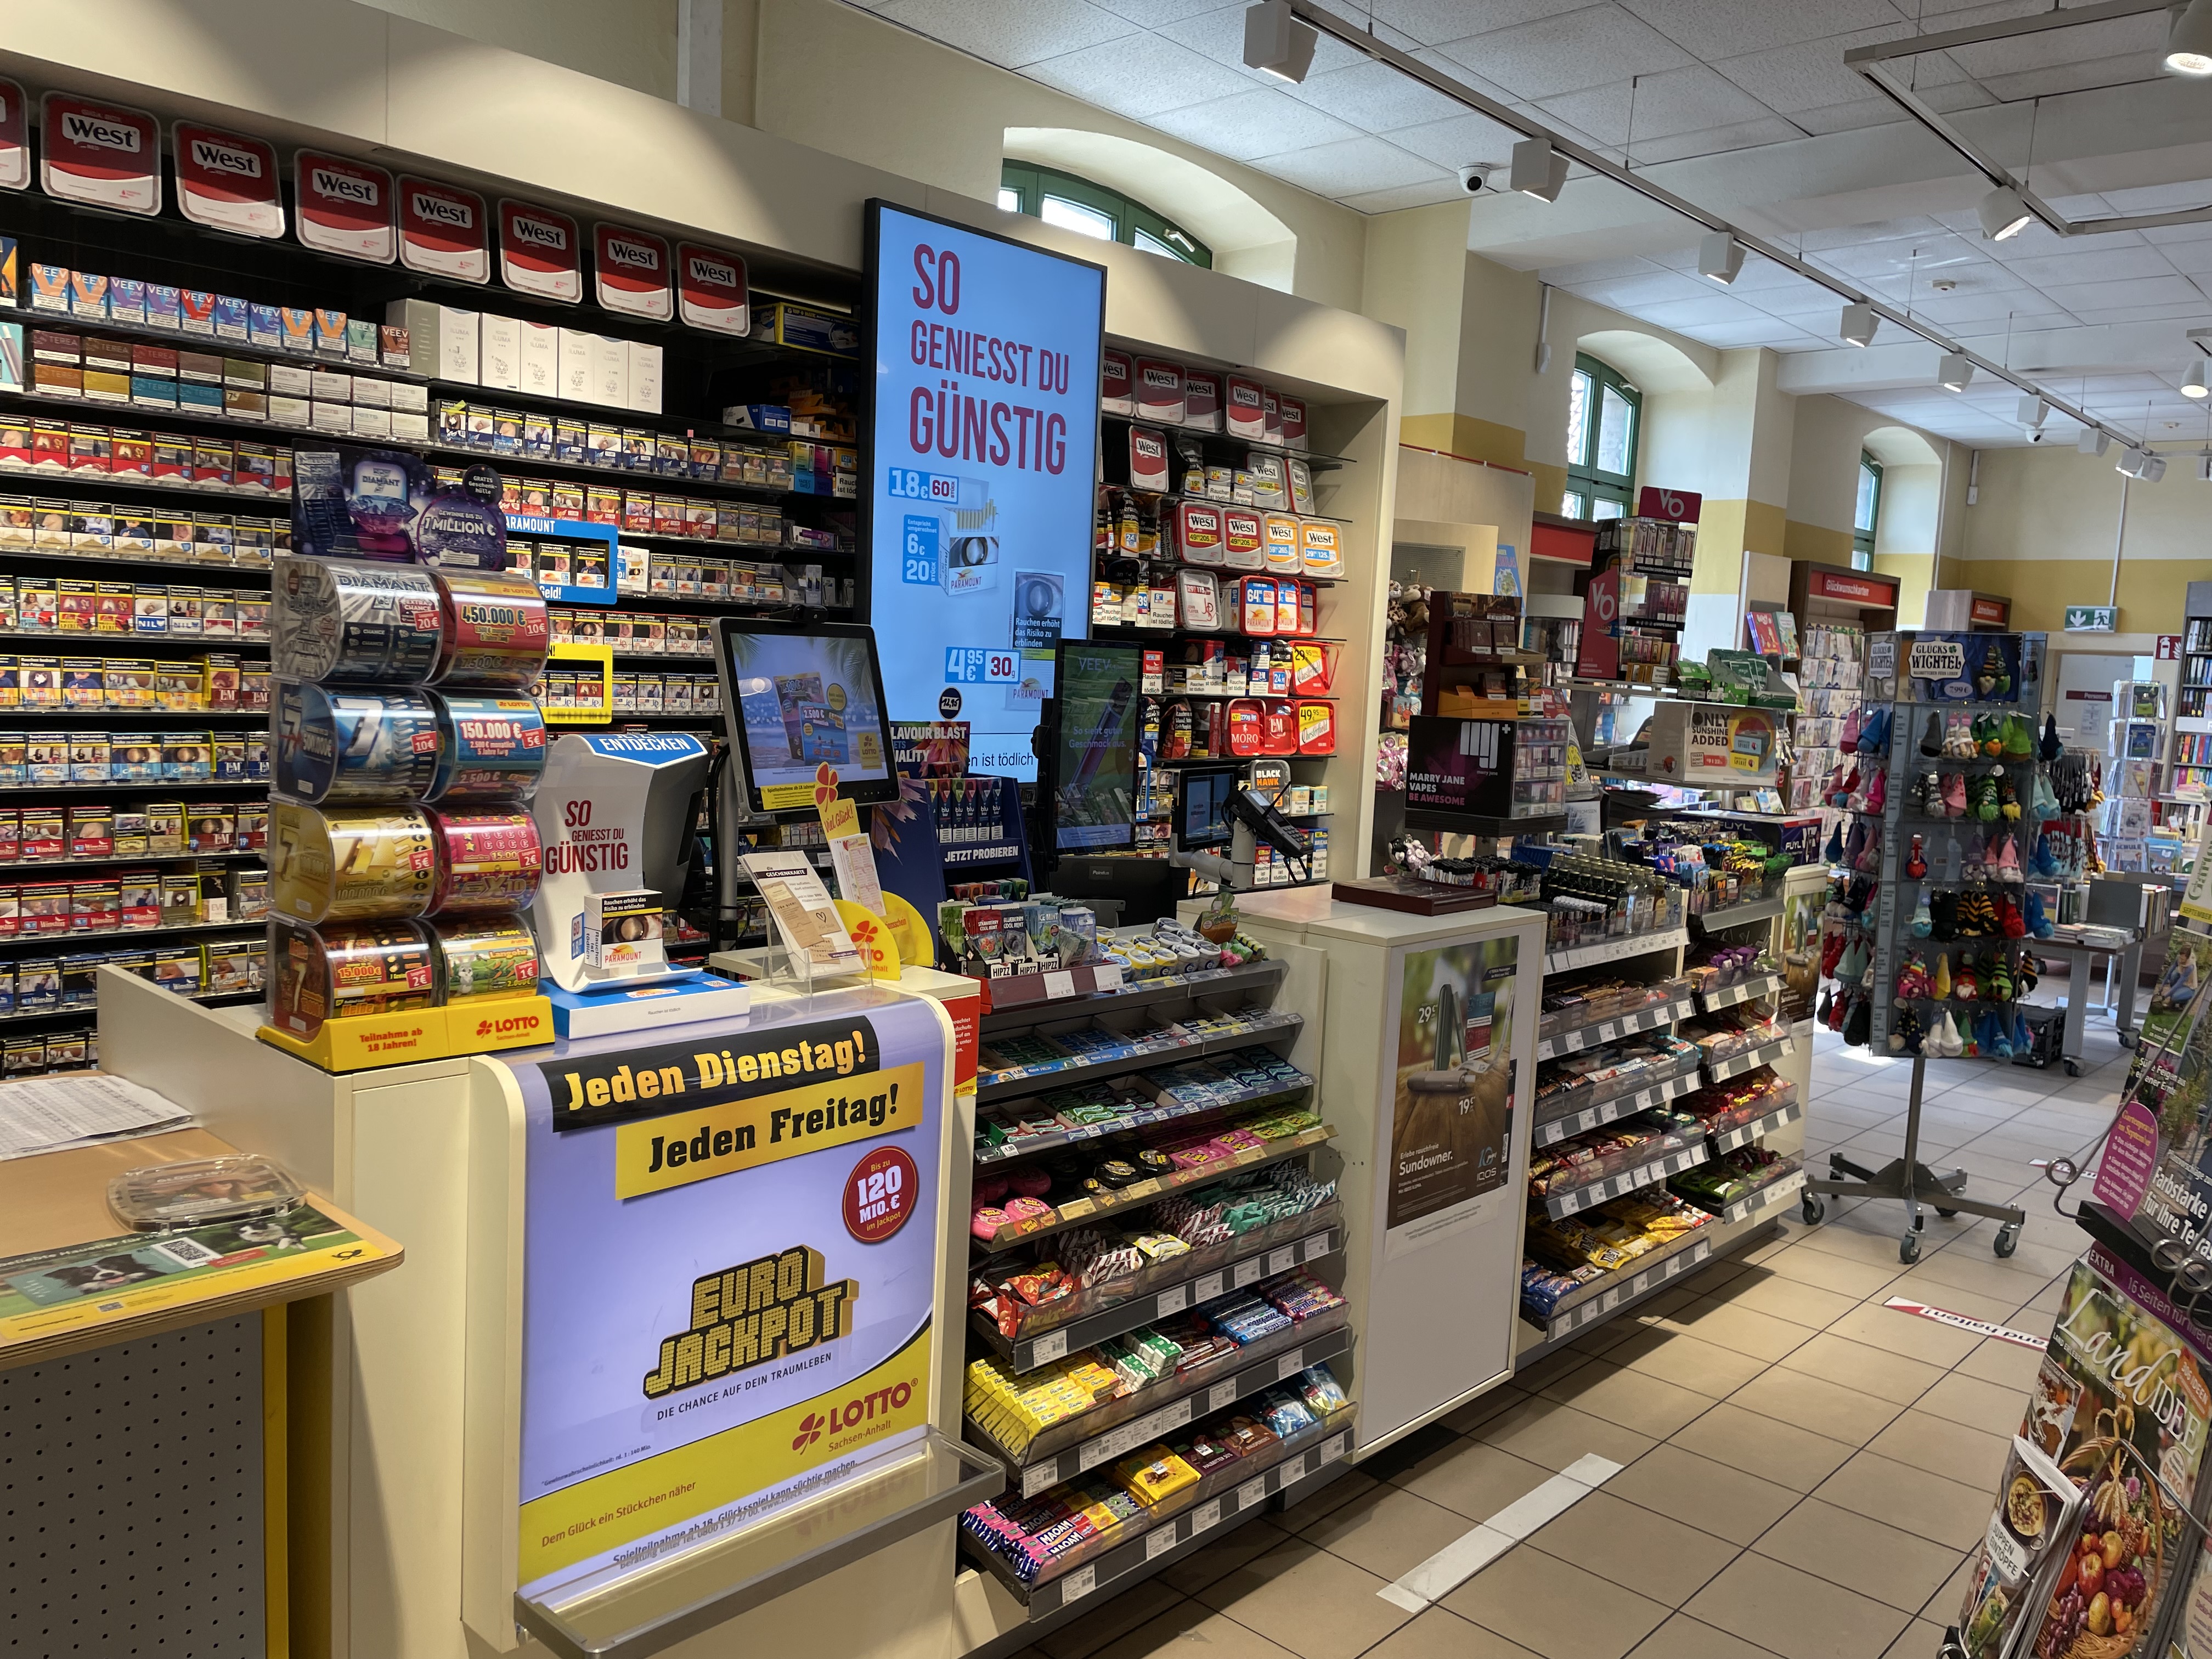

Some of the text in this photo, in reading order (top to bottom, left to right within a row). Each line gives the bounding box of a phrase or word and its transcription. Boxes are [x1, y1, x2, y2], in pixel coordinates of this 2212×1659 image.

[67, 116, 133, 148] West
[197, 145, 255, 173] West
[317, 172, 373, 202] West
[417, 196, 467, 225] West
[518, 219, 561, 246] West
[33, 264, 69, 279] VEEV
[913, 243, 960, 315] SO
[911, 320, 1069, 395] GENIESST DU
[910, 380, 1066, 475] GÜNSTIG
[362, 476, 400, 488] DIAMANT
[438, 510, 464, 518] GEWINNE
[432, 520, 484, 535] MILLION
[486, 523, 496, 536] €
[907, 560, 929, 581] 20
[338, 575, 429, 591] DIAMANT
[951, 576, 982, 590] PARAMOUNT
[462, 606, 526, 625] 450.000 €
[1246, 618, 1272, 628] PARAMOUNT
[527, 622, 546, 634] 10€
[1015, 618, 1060, 630] Rauchen erhöht
[1015, 628, 1025, 637] das
[1027, 629, 1044, 637] Risiko
[1015, 639, 1042, 648] erblinden
[1916, 644, 1948, 654] GLÜCKS
[1013, 689, 1048, 699] PARAMOUNT
[460, 721, 522, 739] 150.000 €
[890, 727, 967, 740] LAVOUR BLAST
[1074, 726, 1082, 735] So
[1692, 726, 1729, 736] SUNSHINE
[527, 735, 540, 747] 5€
[599, 738, 691, 752] ENTDECKEN
[1069, 739, 1111, 748] Geschmack
[1231, 734, 1259, 743] MORO
[1691, 735, 1728, 746] ADDED
[982, 753, 1034, 767] ist tödlich
[1256, 770, 1280, 779] BLACK
[1410, 772, 1465, 786] MARRY JANE
[1409, 782, 1437, 793] VAPES
[1409, 792, 1465, 806] BE AWESOME
[565, 799, 592, 827] SO
[572, 828, 624, 842] GENIESST DU
[1785, 840, 1802, 850] FUYL
[524, 854, 537, 865] 2€
[545, 840, 629, 874] GÜNSTIG
[944, 845, 1018, 862] JETZT PROBIEREN
[766, 869, 805, 878] GESCHENKKARTE
[489, 948, 528, 959] Langohr
[605, 951, 642, 964] PARAMOUNT
[520, 967, 534, 978] 1€
[992, 968, 1011, 977] HIPZZ
[1019, 965, 1037, 974] HIPZZ
[1041, 961, 1058, 970] HIPZZ
[495, 1016, 539, 1032] LOTTO
[360, 1028, 422, 1043] Teilnahme ab
[368, 1039, 417, 1052] 18 Jahren!
[565, 1030, 868, 1112] Jeden Dienstag!
[648, 1082, 900, 1175] Jeden Freitag!
[1400, 1143, 1439, 1160] Erlebe rauchfreie
[871, 1159, 890, 1172] Bis zu
[1399, 1150, 1453, 1176] Sundowner.
[1477, 1167, 1497, 1182] IQOS
[857, 1165, 902, 1207] 120
[2152, 1165, 2208, 1220] Farbstarke
[859, 1200, 890, 1224] MIO.
[2143, 1192, 2179, 1235] für Ihre
[866, 1211, 901, 1232] im Jackpot
[2089, 1249, 2115, 1278] EXTRA
[691, 1249, 805, 1332] EURO
[2128, 1277, 2138, 1294] 16
[2138, 1283, 2171, 1316] Seiten
[1291, 1299, 1318, 1314] mentos
[1925, 1308, 1998, 1335] halten!
[644, 1285, 843, 1396] JACKPOT
[657, 1352, 833, 1421] DIE CHANCE AUF DEIN TRAUMLEBEN
[2148, 1377, 2202, 1456] IDEE
[828, 1420, 893, 1452] Sachsen-Anhalt
[541, 1481, 696, 1548] Dem Glück ein Stückchen näher
[1020, 1509, 1056, 1534] MAOAM
[1040, 1519, 1074, 1546] MAOAM
[1992, 1523, 2016, 1557] SUPPEN
[1989, 1536, 2018, 1576] EINTÖPFE
